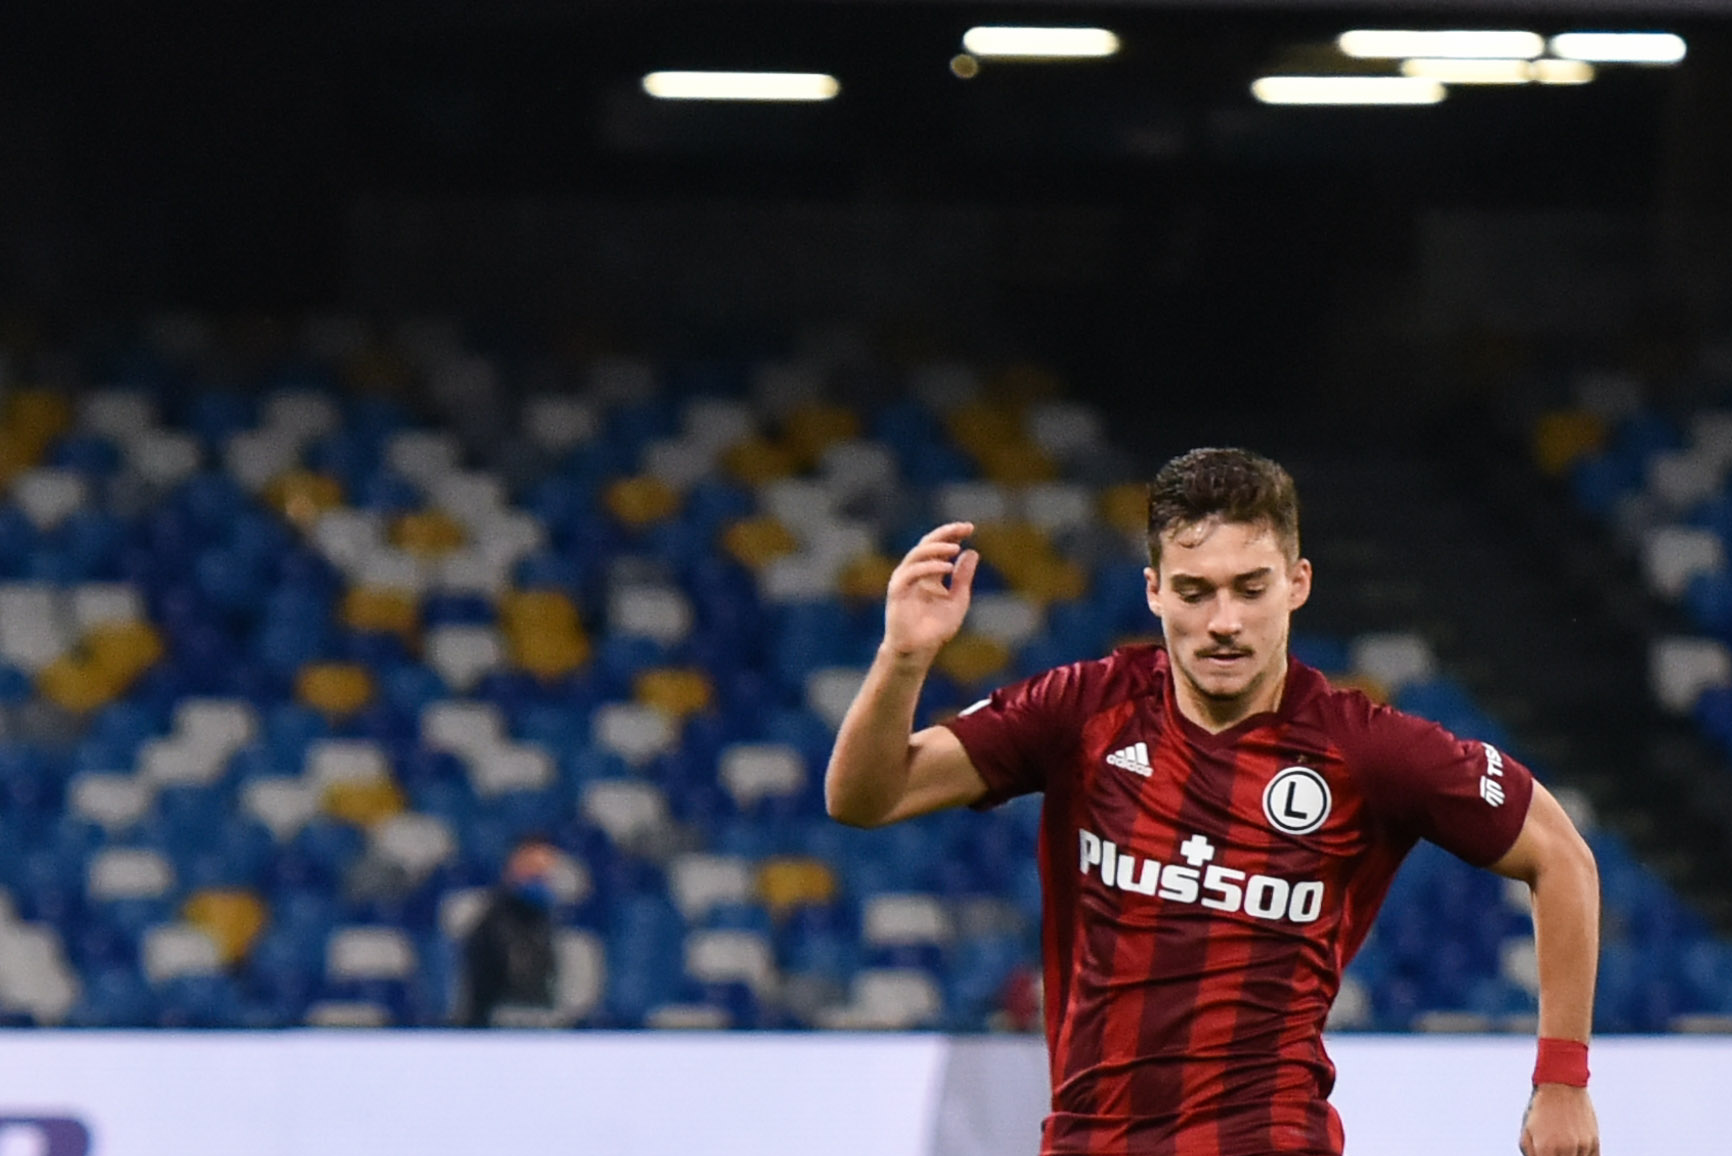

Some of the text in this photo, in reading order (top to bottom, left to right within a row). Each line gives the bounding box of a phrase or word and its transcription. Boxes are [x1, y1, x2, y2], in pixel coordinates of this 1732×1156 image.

[1106, 754, 1154, 777] adidas
[1283, 781, 1308, 820] L
[1079, 827, 1325, 923] Plus500
